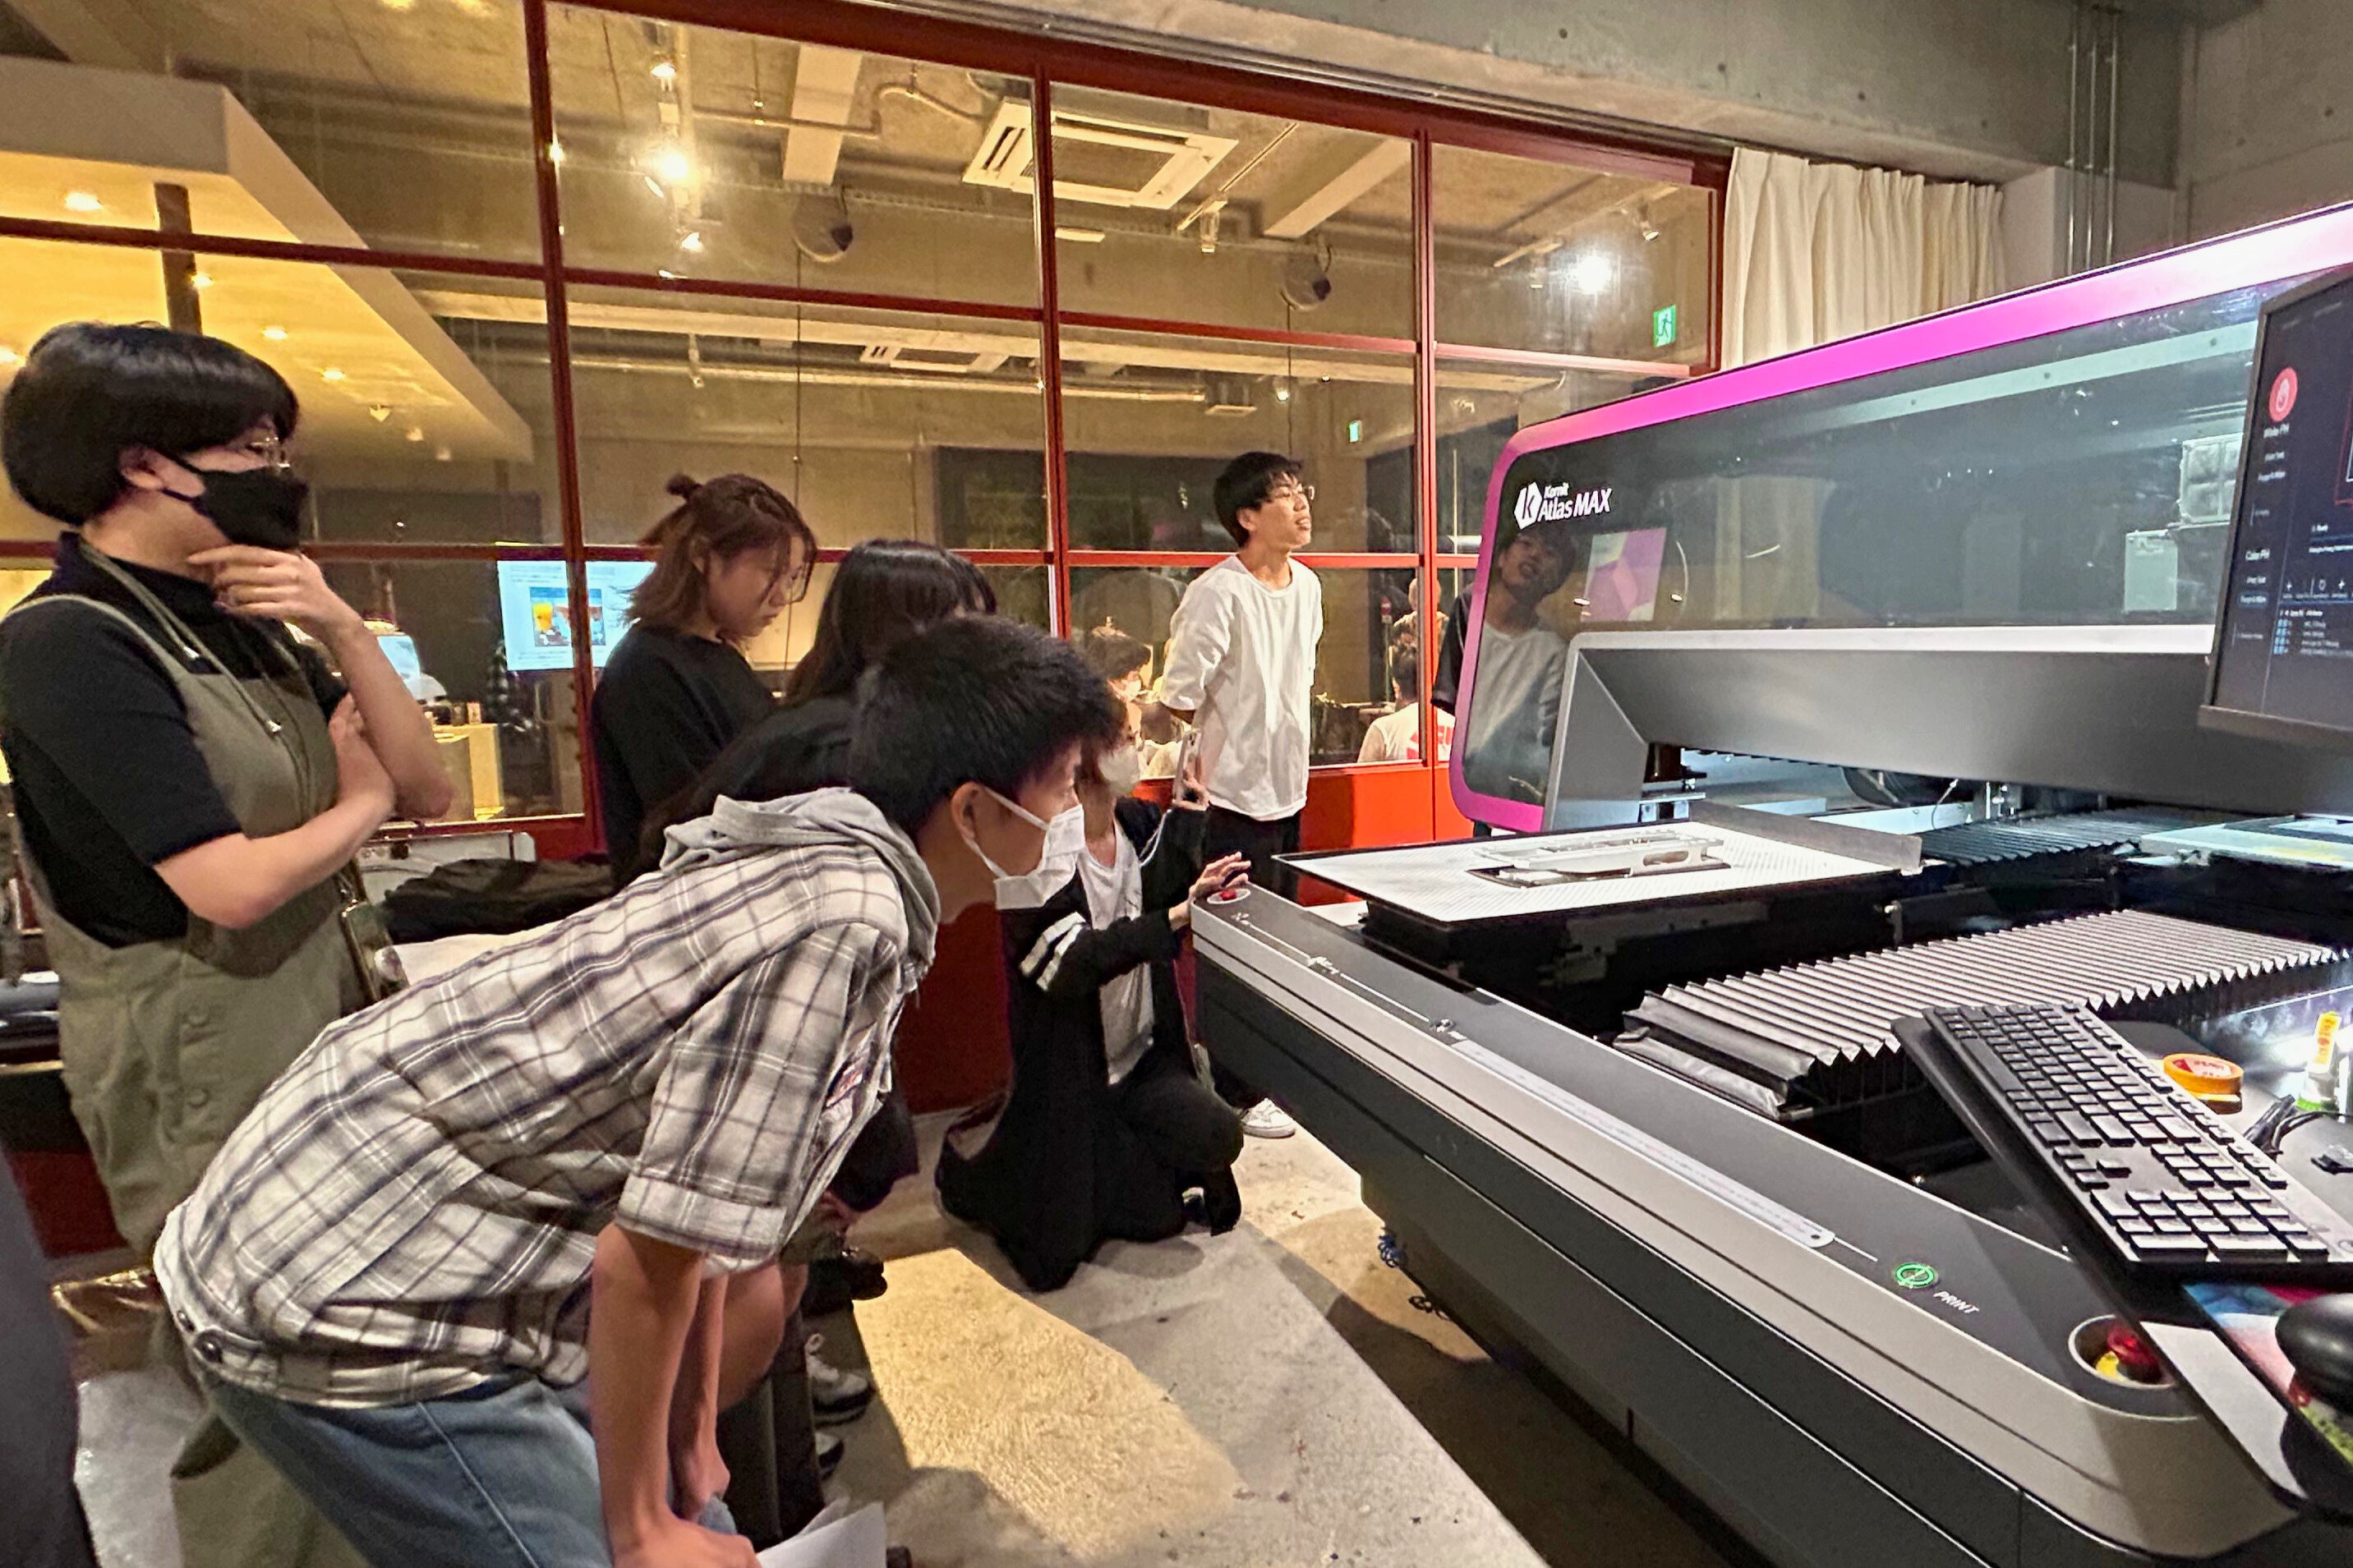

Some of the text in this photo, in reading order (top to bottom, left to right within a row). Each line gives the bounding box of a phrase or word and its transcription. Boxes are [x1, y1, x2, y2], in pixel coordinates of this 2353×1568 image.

[1537, 488, 1613, 522] Atlas MAX
[1933, 1290, 1979, 1313] PRINT
